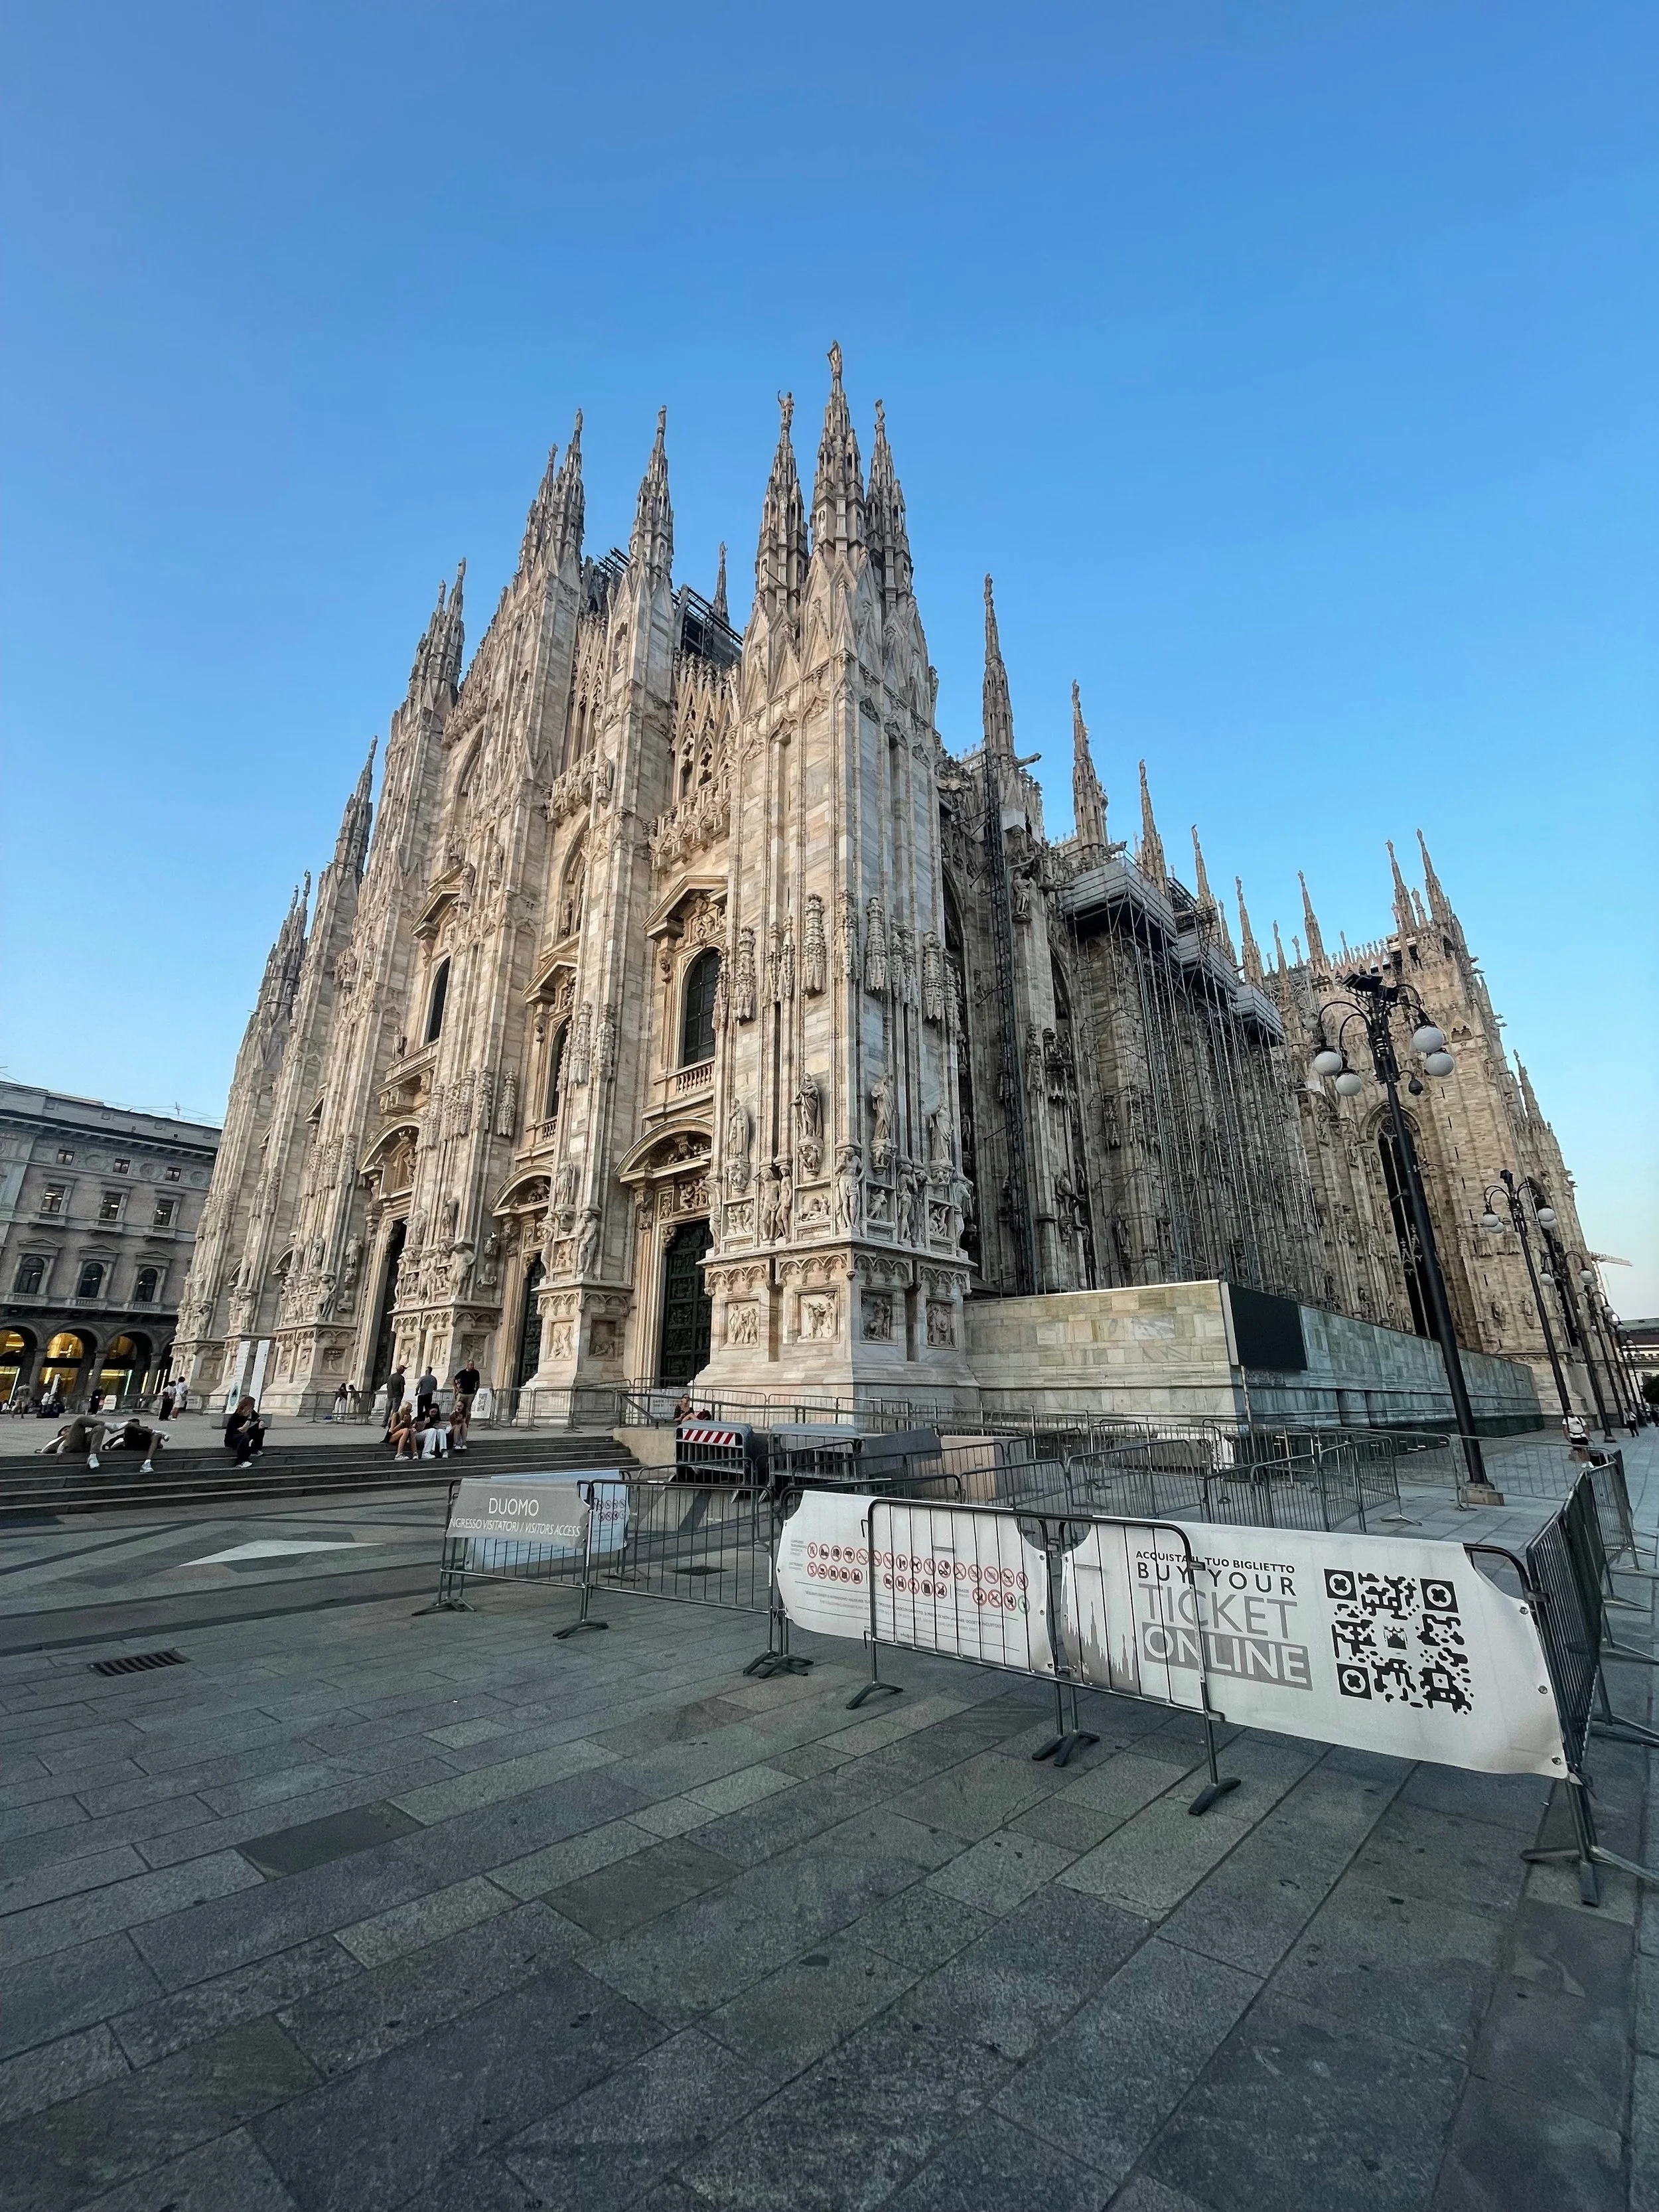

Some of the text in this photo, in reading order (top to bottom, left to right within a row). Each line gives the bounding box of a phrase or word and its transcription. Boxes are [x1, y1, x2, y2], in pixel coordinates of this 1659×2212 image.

[488, 1497, 540, 1516] DUOMO
[449, 1517, 482, 1529] NGRESSO
[482, 1519, 519, 1532] VISITATORI
[525, 1522, 555, 1535] VISITORS
[553, 1524, 581, 1537] ACCESS
[1204, 1556, 1230, 1568] TUO
[1232, 1560, 1295, 1574] BIGLIETTO
[1137, 1562, 1297, 1597] BUY YOUR
[1138, 1583, 1298, 1639] TICKET
[1143, 1625, 1307, 1684] ONLINE
